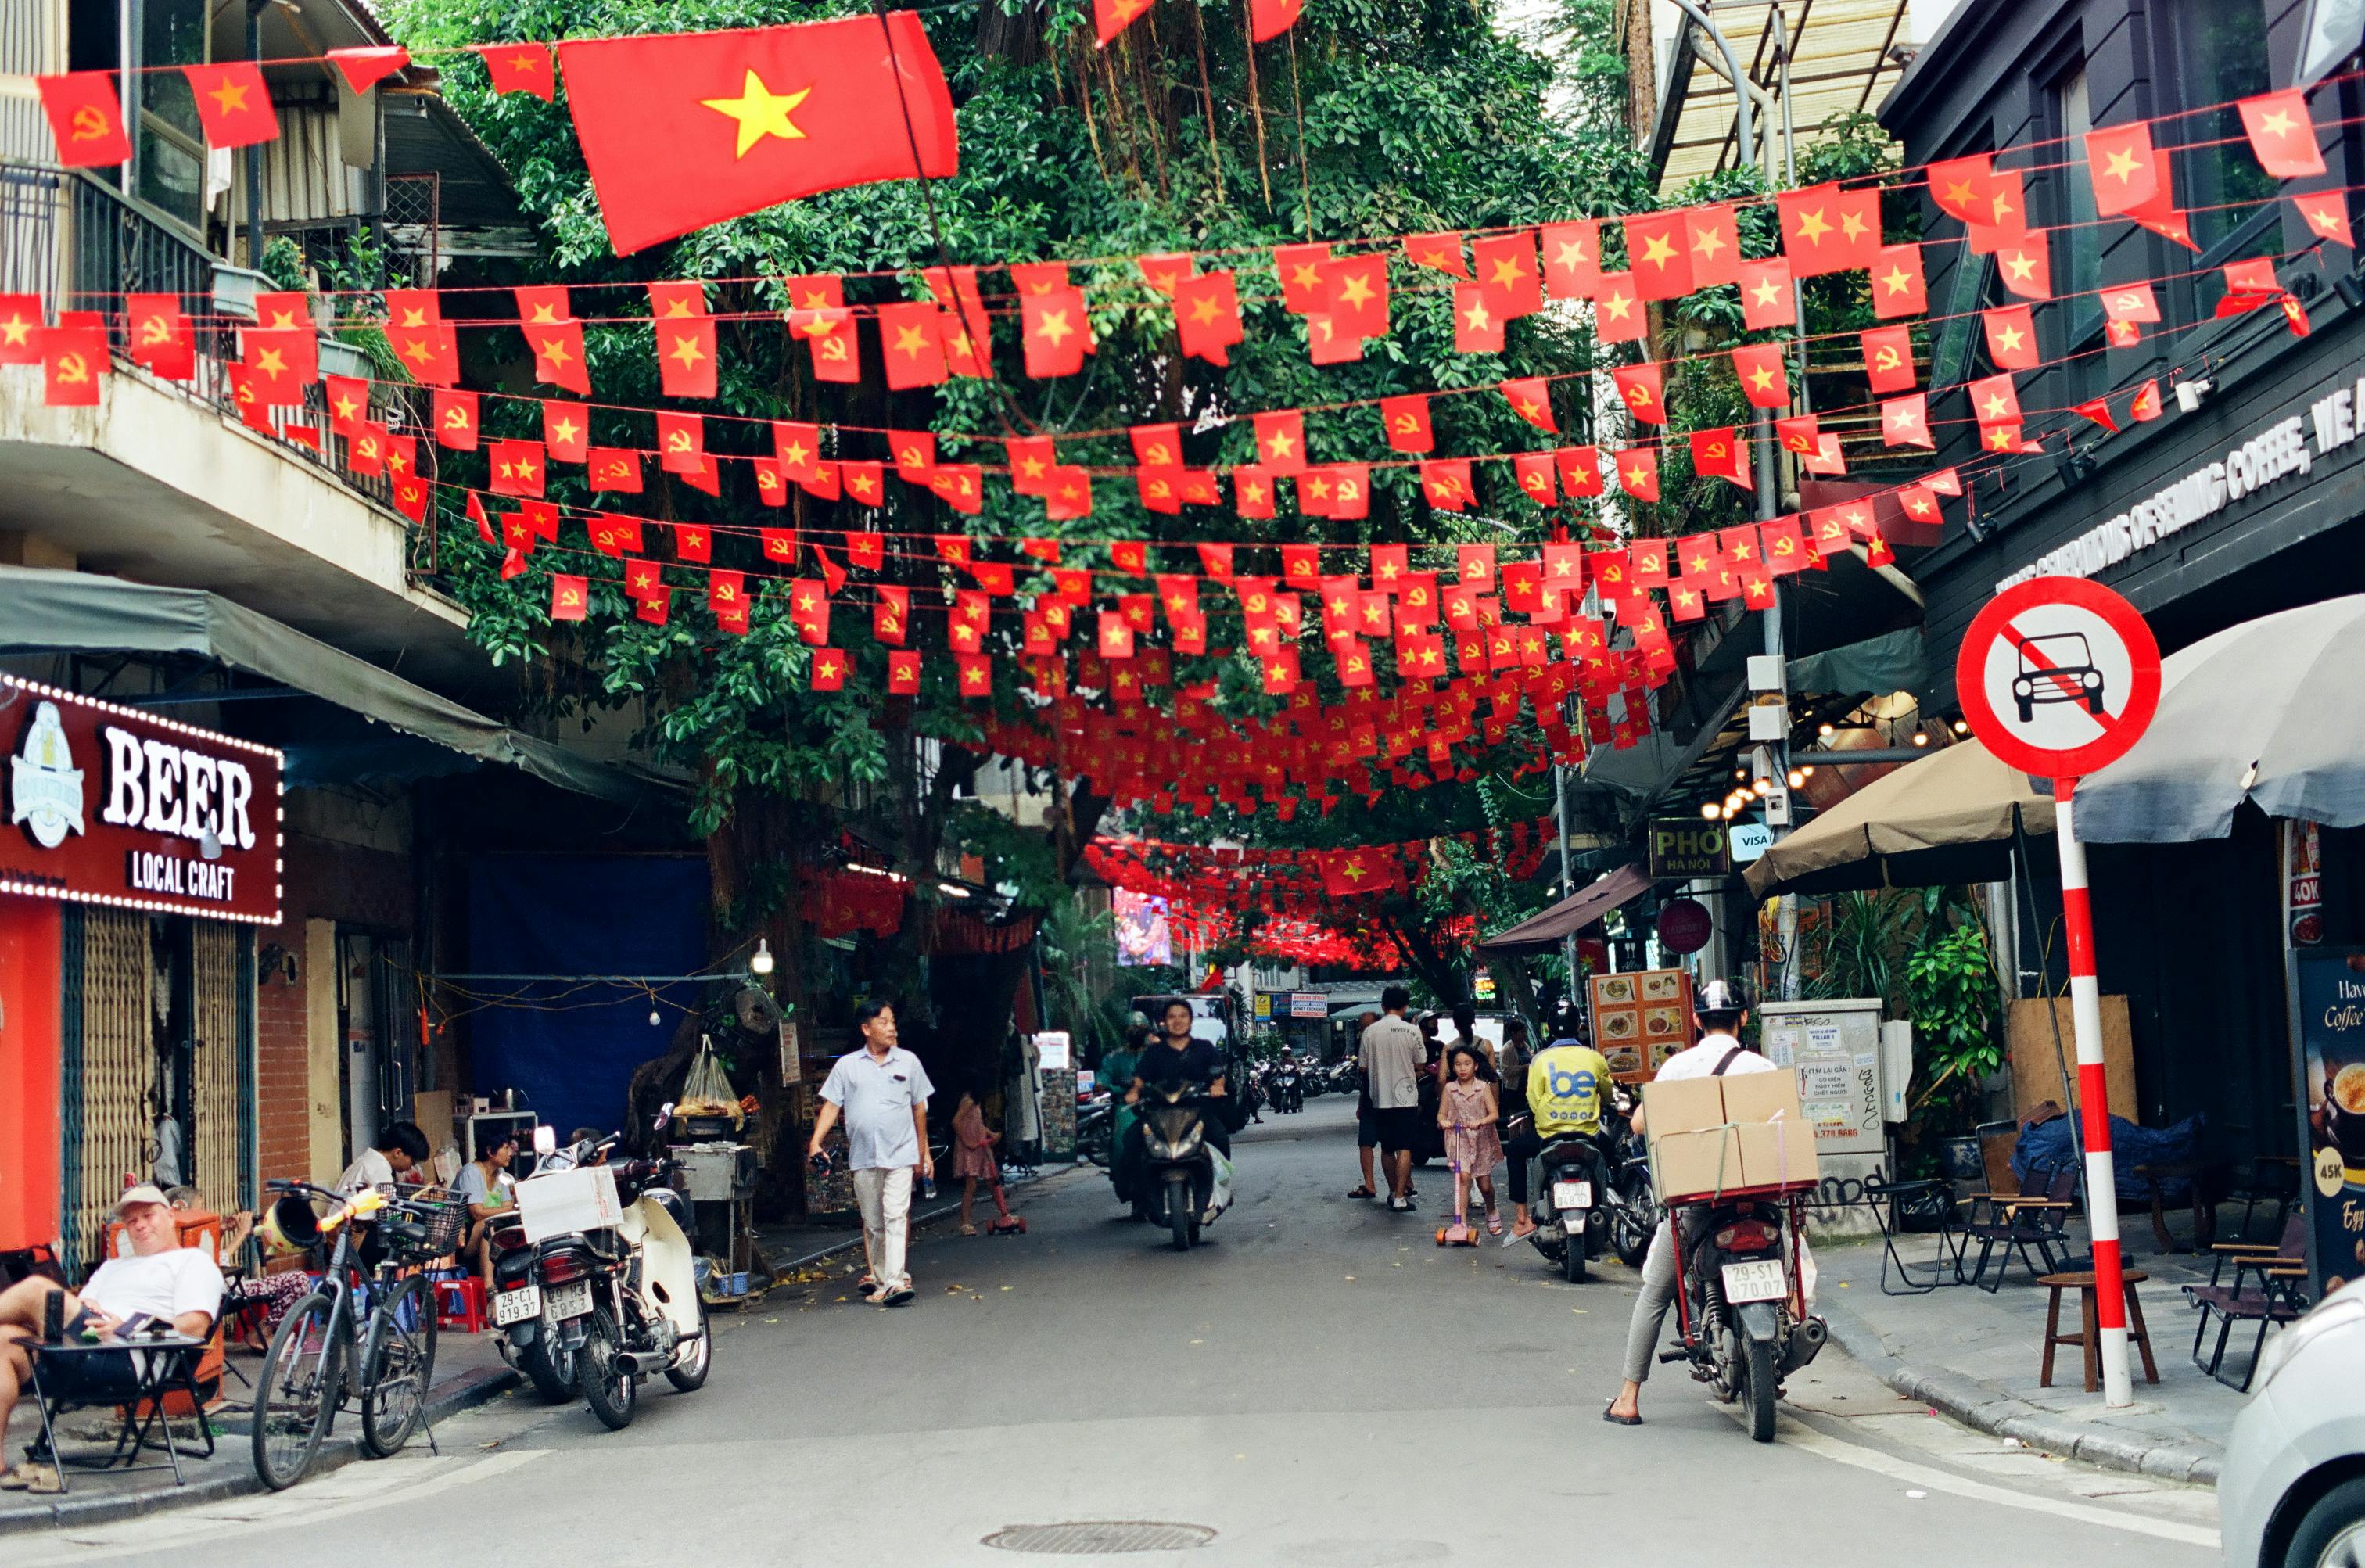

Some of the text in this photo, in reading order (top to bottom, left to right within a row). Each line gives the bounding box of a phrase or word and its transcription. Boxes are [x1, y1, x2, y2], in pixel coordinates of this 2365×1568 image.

[2130, 499, 2157, 550] OF
[2227, 416, 2311, 500] COFFEE,
[2312, 389, 2355, 454] WE
[103, 726, 256, 850] BEER
[1656, 823, 1723, 856] PHỞ
[1742, 835, 1768, 846] VISA
[133, 850, 235, 901] LOCAL CRAFT
[2295, 881, 2320, 902] 40K
[2324, 1005, 2363, 1032] Coffee
[1548, 1062, 1596, 1099] be
[2320, 1164, 2342, 1179] 45K
[1732, 1263, 1774, 1283] 29-S1
[501, 1288, 532, 1308] 29-C1
[499, 1301, 536, 1323] 919.37
